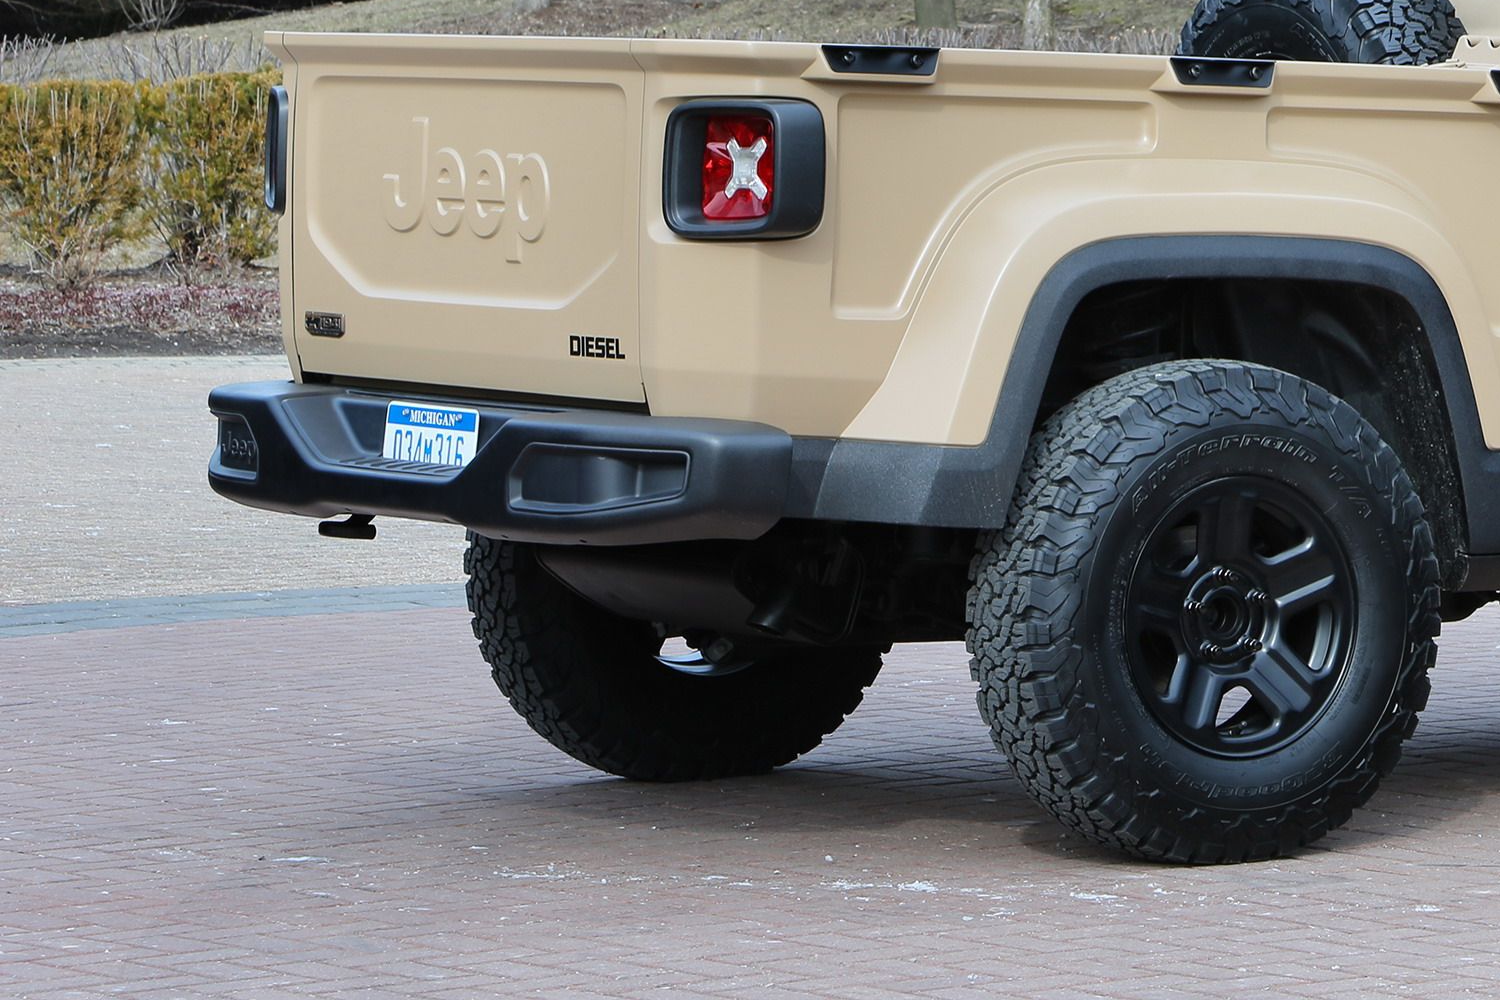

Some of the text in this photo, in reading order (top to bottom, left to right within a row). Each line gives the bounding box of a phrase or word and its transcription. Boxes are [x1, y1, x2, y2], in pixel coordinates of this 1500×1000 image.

[382, 116, 550, 265] Jeep
[569, 335, 626, 360] DIESEL
[409, 408, 456, 427] MICHIGAN
[221, 430, 258, 465] Jeep
